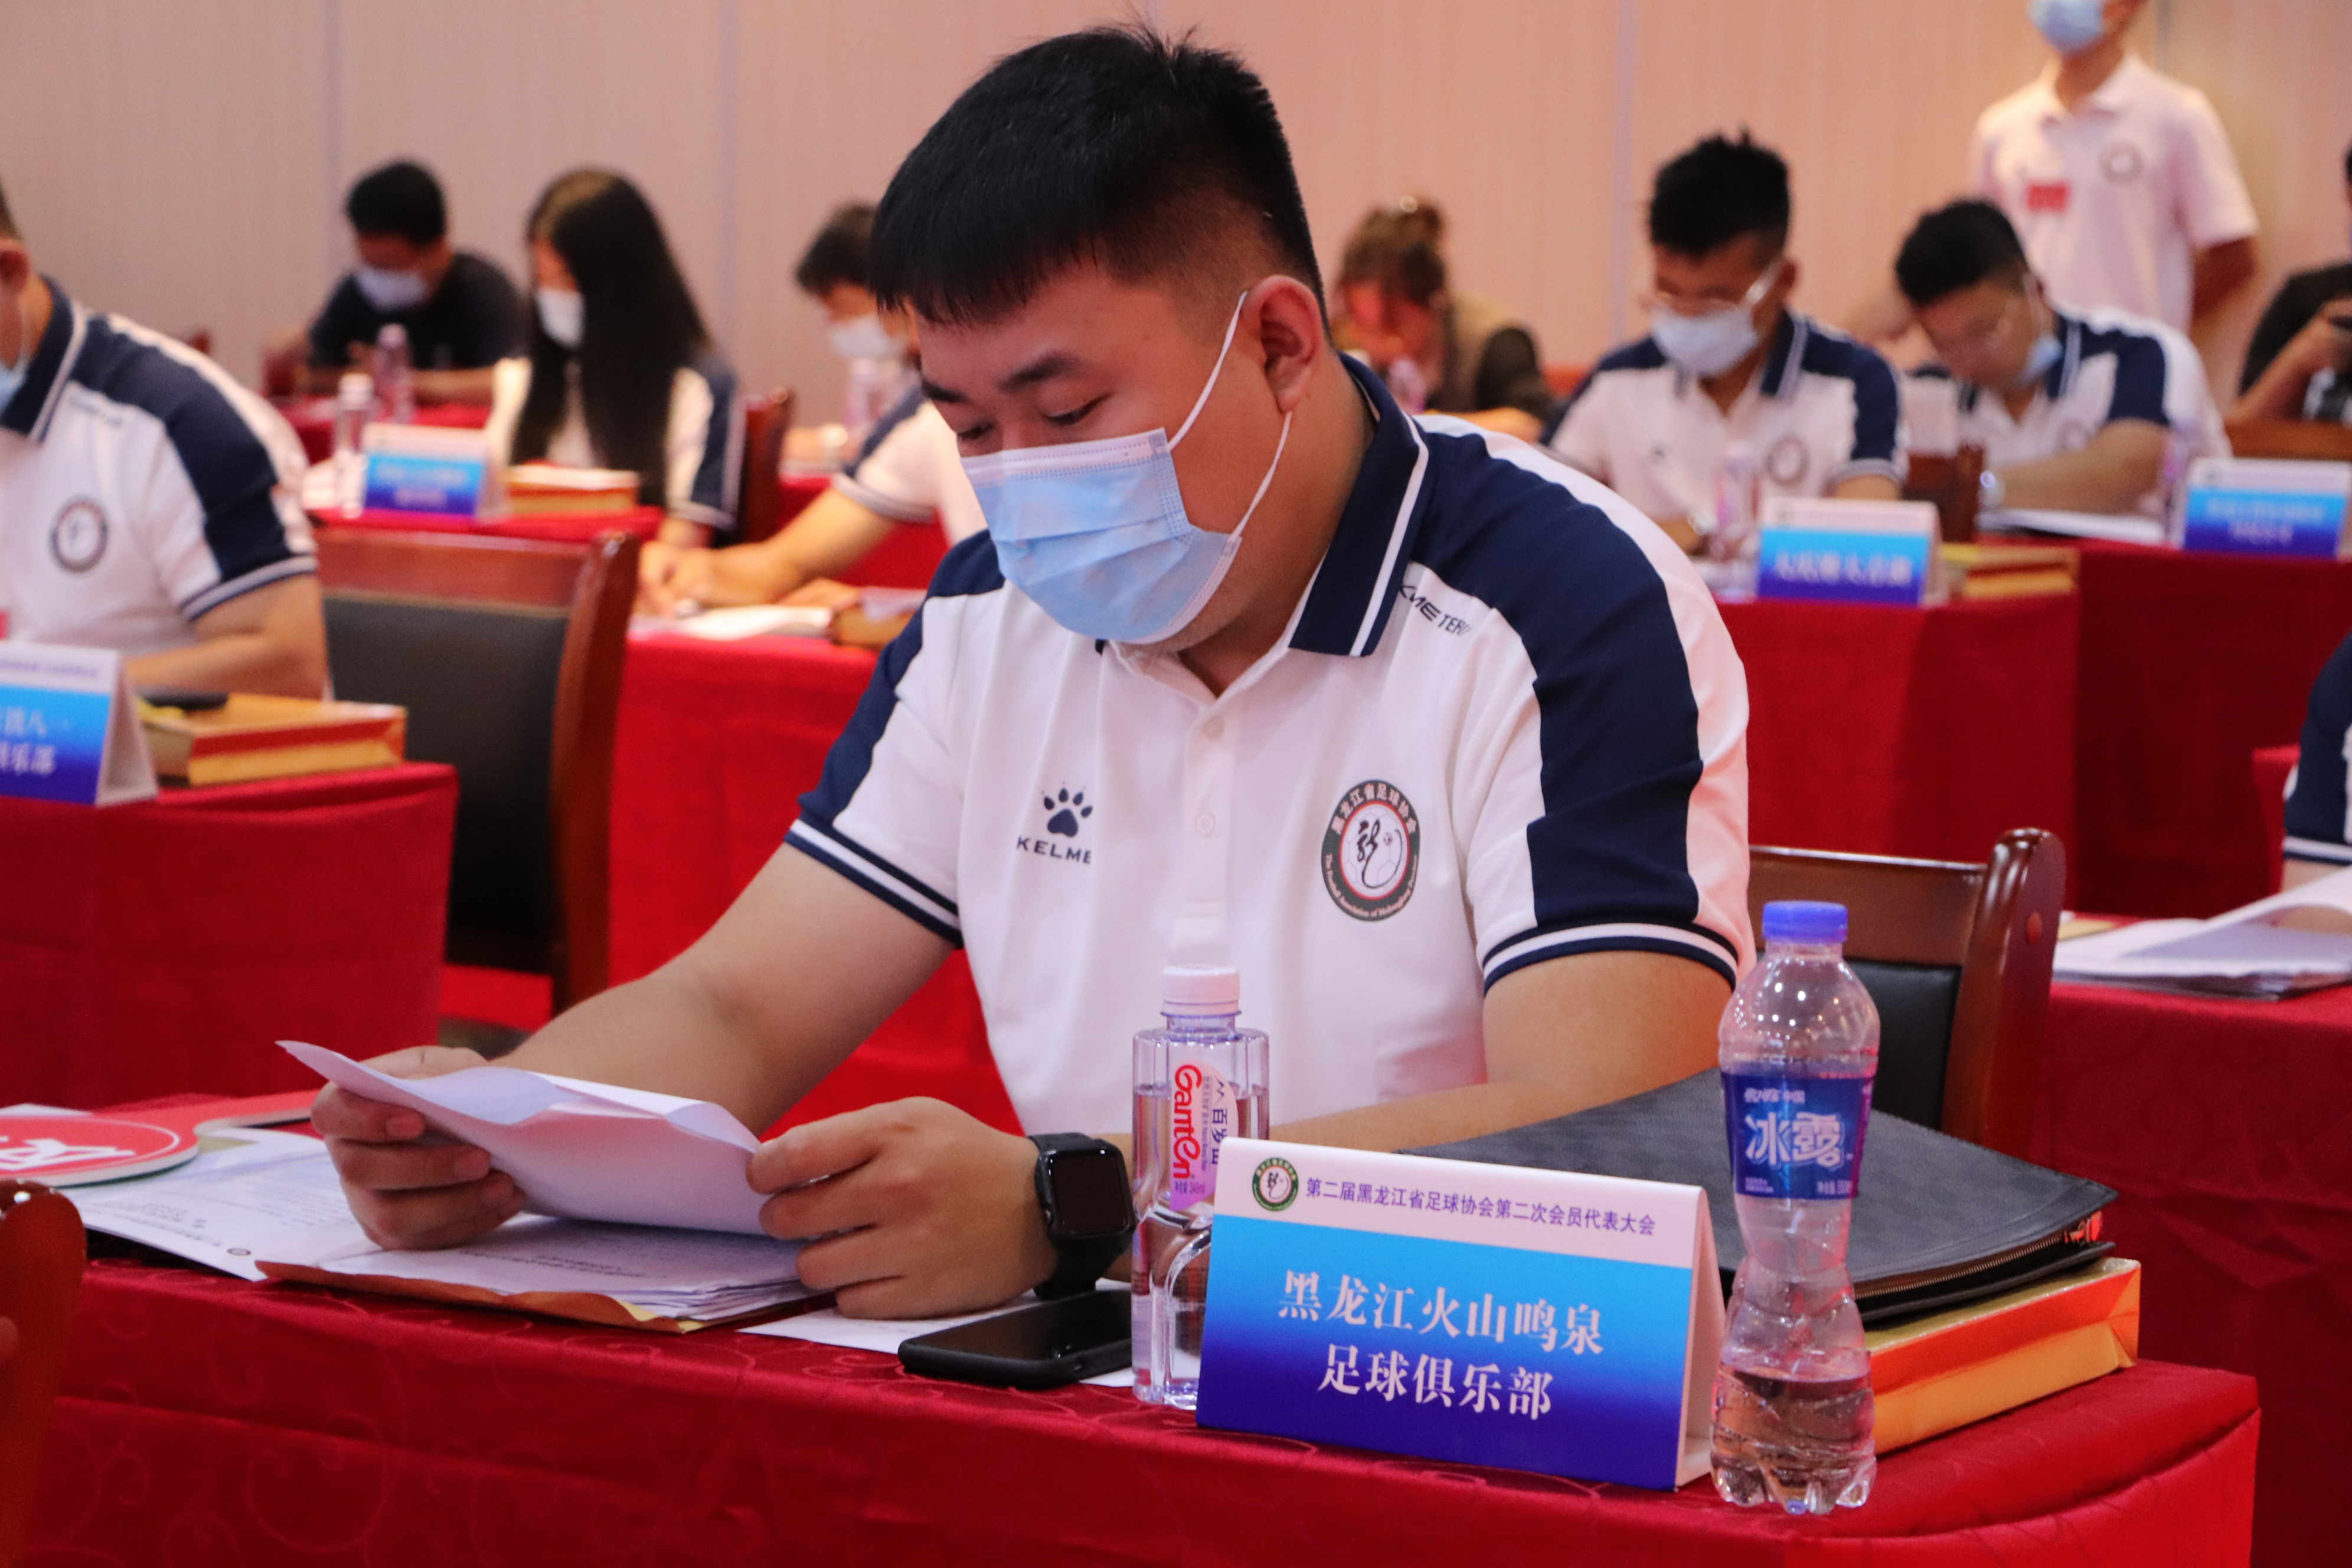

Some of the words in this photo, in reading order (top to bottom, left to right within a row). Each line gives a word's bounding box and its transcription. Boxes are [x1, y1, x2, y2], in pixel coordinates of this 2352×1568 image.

[1017, 835, 1092, 865] KELME
[1211, 1108, 1228, 1165] 百岁山
[1745, 1112, 1841, 1168] 冰露
[1306, 1177, 1655, 1236] 第二届黑龙江省足球协会第二次会员代表大会
[1279, 1270, 1604, 1354] 黑龙江火山鸣泉
[1317, 1343, 1554, 1420] 足球俱乐部
